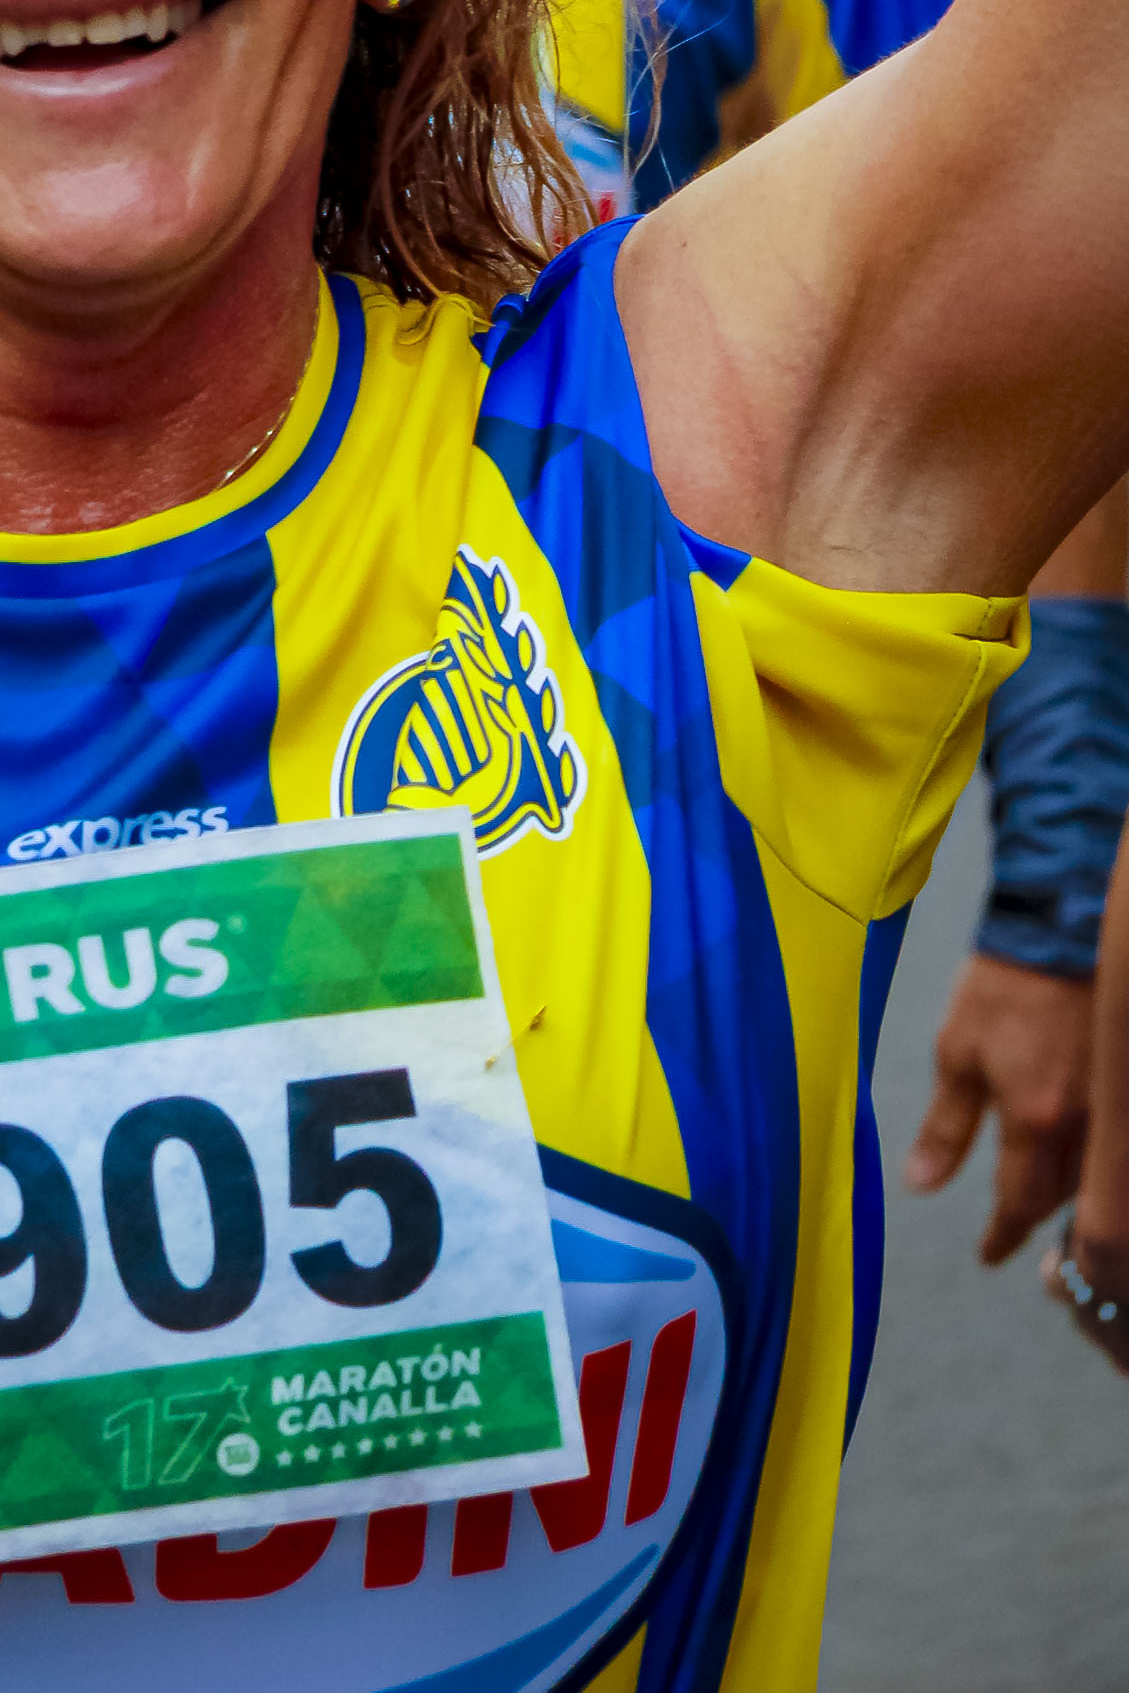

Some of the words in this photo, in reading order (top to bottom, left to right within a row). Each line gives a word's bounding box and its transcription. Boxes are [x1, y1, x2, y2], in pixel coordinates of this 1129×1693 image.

[7, 806, 229, 861] express
[2, 918, 230, 1023] RUS
[271, 1343, 482, 1406] MARATÓN
[102, 1376, 251, 1491] 17
[276, 1380, 482, 1437] CANALLA
